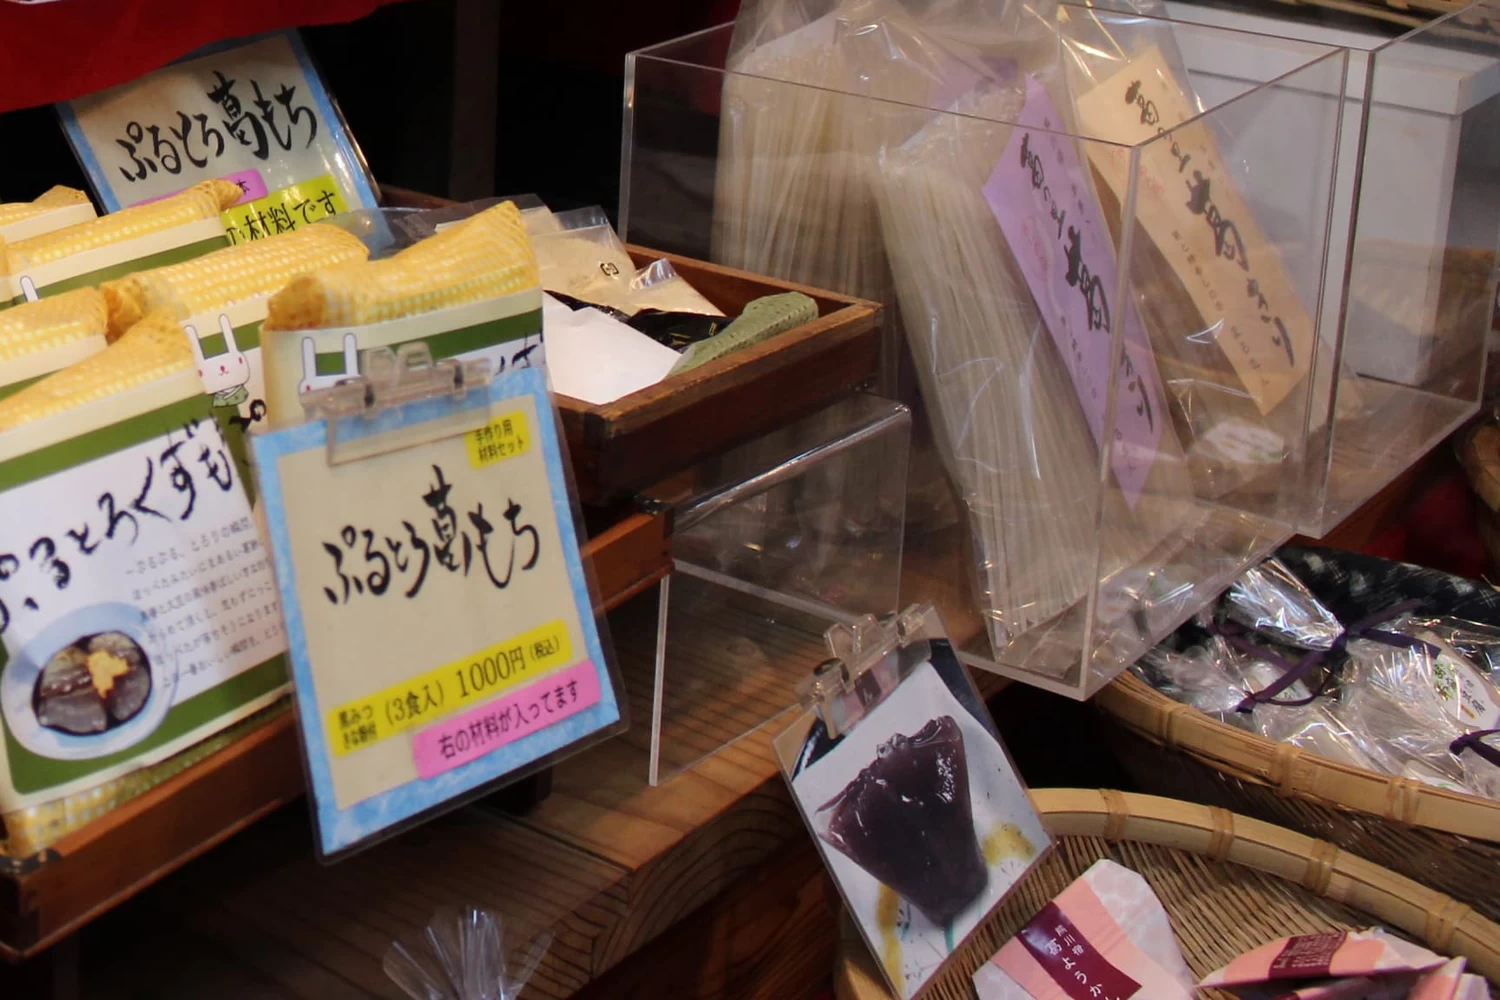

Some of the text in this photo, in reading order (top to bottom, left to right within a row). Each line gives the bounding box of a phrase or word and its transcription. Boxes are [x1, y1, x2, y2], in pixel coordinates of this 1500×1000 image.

[115, 69, 318, 183] ぷるとろ葛もち
[323, 464, 541, 605] ぷるとろ葛もち
[437, 679, 580, 759] 右の材料が入ってます
[1043, 937, 1122, 1000] 葛ようか
